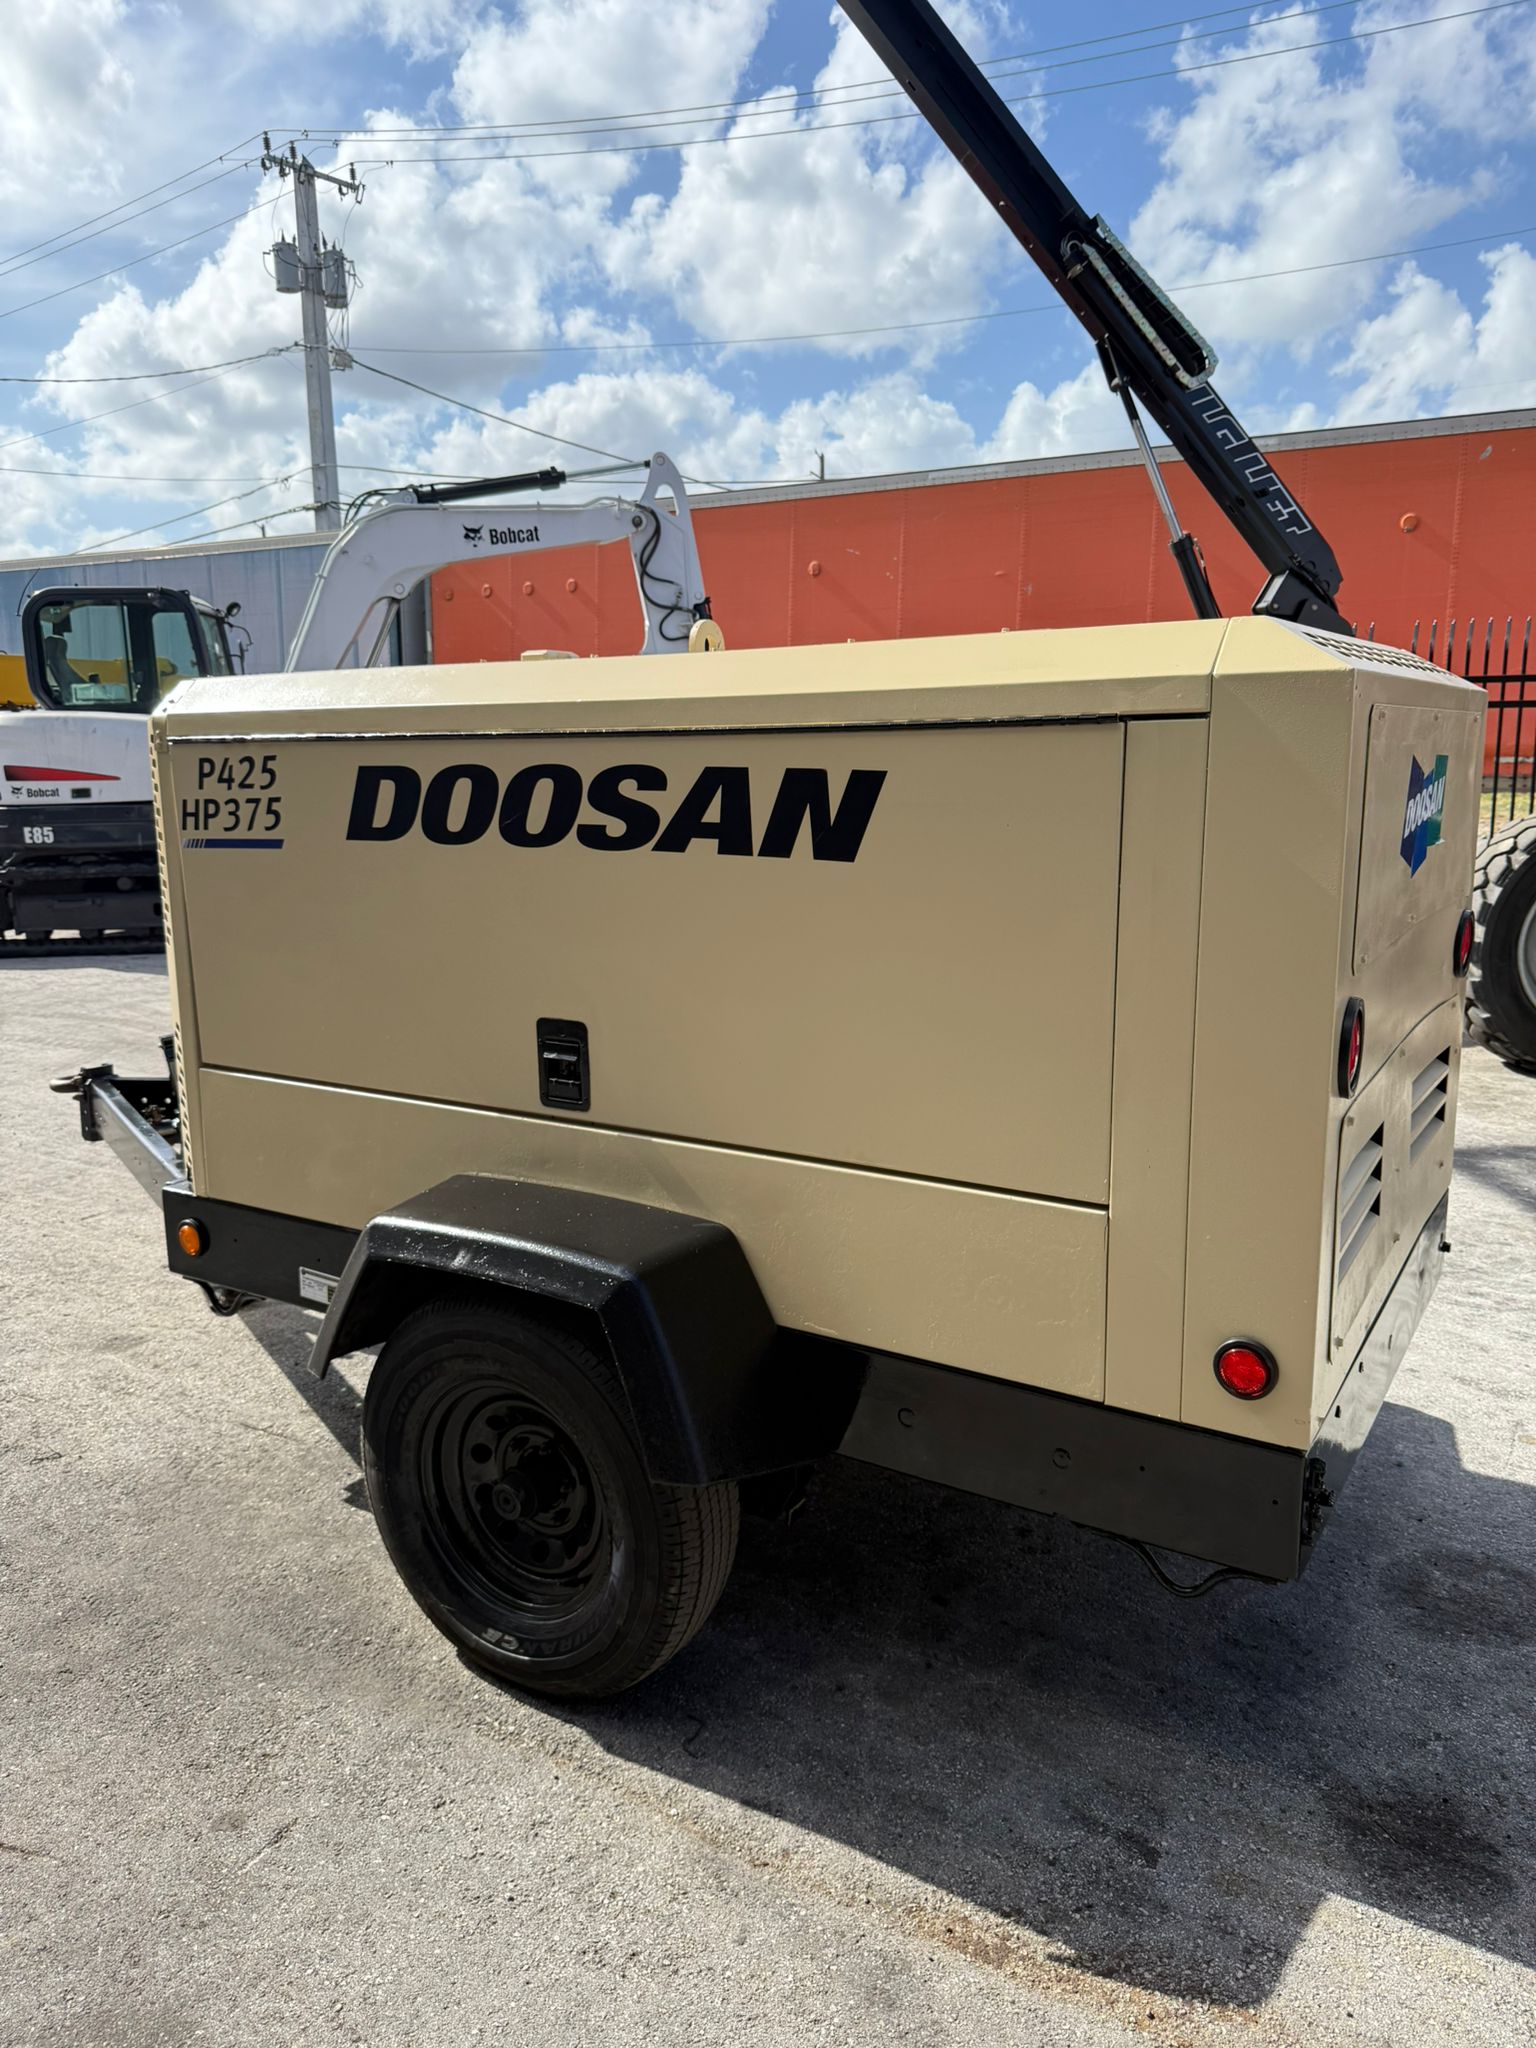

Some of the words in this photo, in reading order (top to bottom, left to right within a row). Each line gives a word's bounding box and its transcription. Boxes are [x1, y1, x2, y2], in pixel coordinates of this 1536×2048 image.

[489, 525, 540, 545] Bobcat
[198, 754, 278, 791] P425
[27, 787, 60, 798] Bobcat
[1403, 775, 1447, 840] DOOSAN
[181, 796, 282, 832] HP375
[345, 763, 888, 863] DOOSAN
[23, 826, 55, 844] E85
